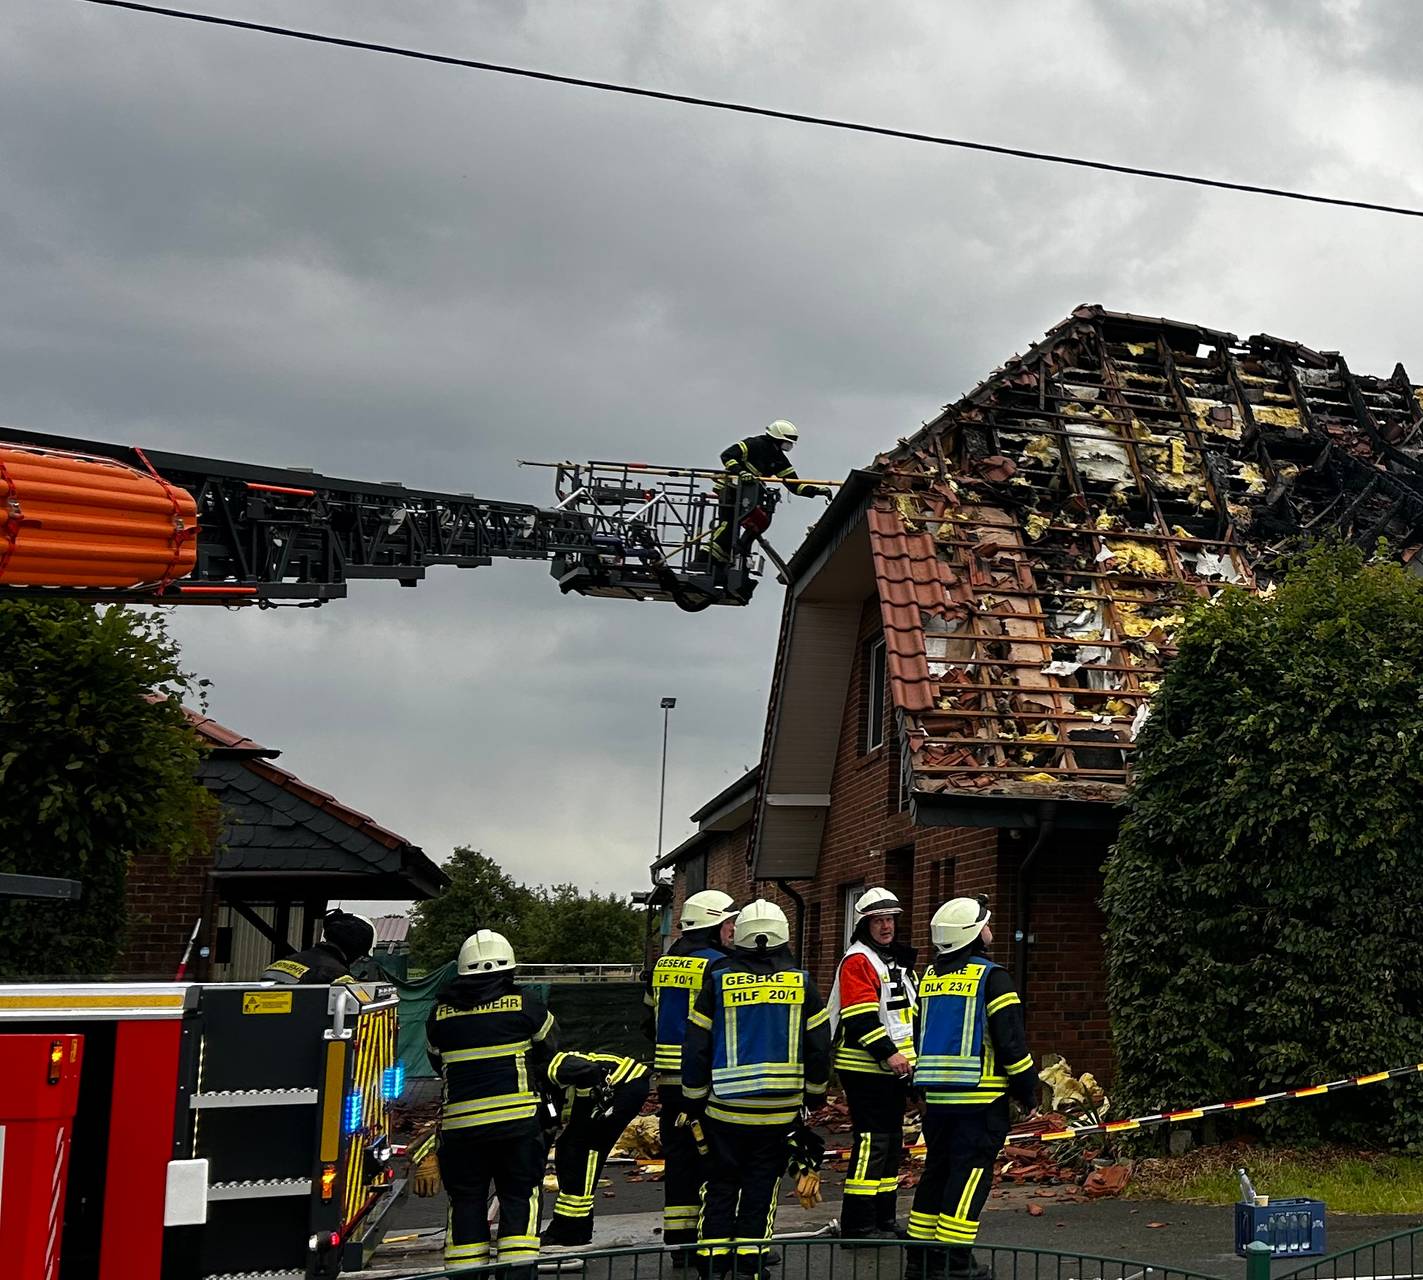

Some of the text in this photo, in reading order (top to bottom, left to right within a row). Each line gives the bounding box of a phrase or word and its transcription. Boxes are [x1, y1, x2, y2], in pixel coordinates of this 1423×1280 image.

[657, 958, 704, 970] GESEKE 4
[976, 967, 982, 975] 1
[659, 975, 693, 986] LF 10/1
[725, 974, 800, 985] GESEKE 1
[925, 982, 972, 992] DLK 23/1
[732, 990, 796, 1003] HLF 20/1
